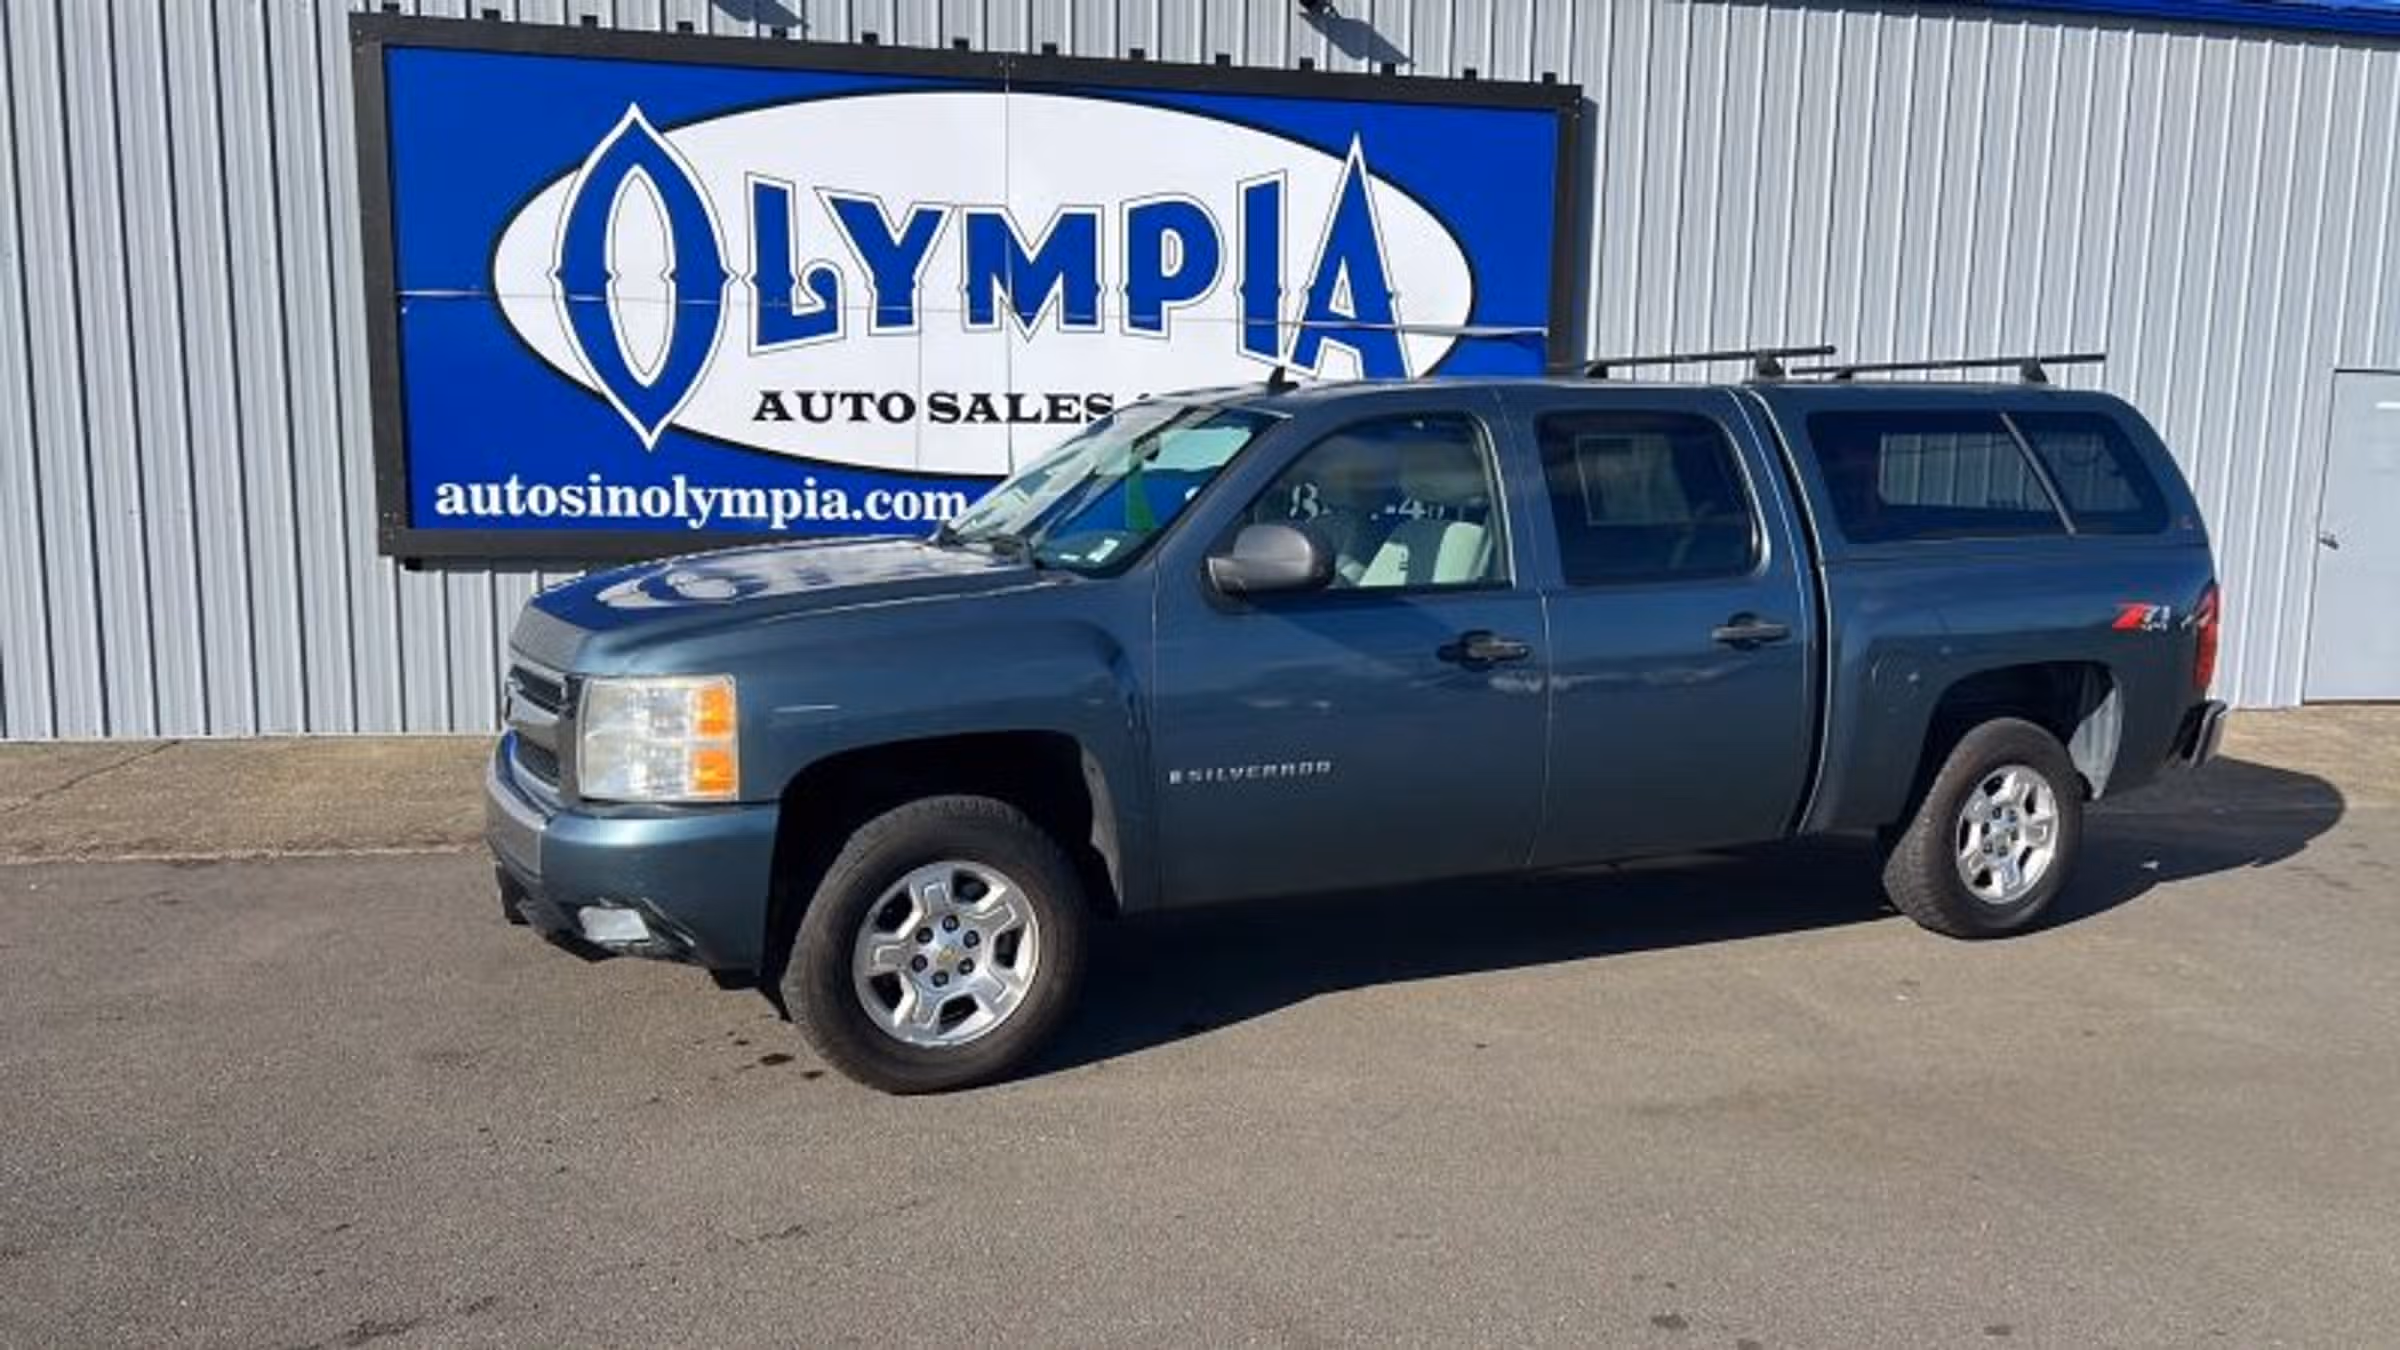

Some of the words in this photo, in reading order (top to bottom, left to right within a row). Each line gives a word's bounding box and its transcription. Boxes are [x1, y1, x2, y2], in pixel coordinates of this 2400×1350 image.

[550, 104, 1410, 451] OLYMPIA
[753, 390, 917, 424] AUTO
[928, 392, 1115, 425] SALES
[435, 474, 967, 530] autosinolympia.com
[2112, 603, 2171, 630] Z71
[1187, 760, 1332, 782] SILVERADO
